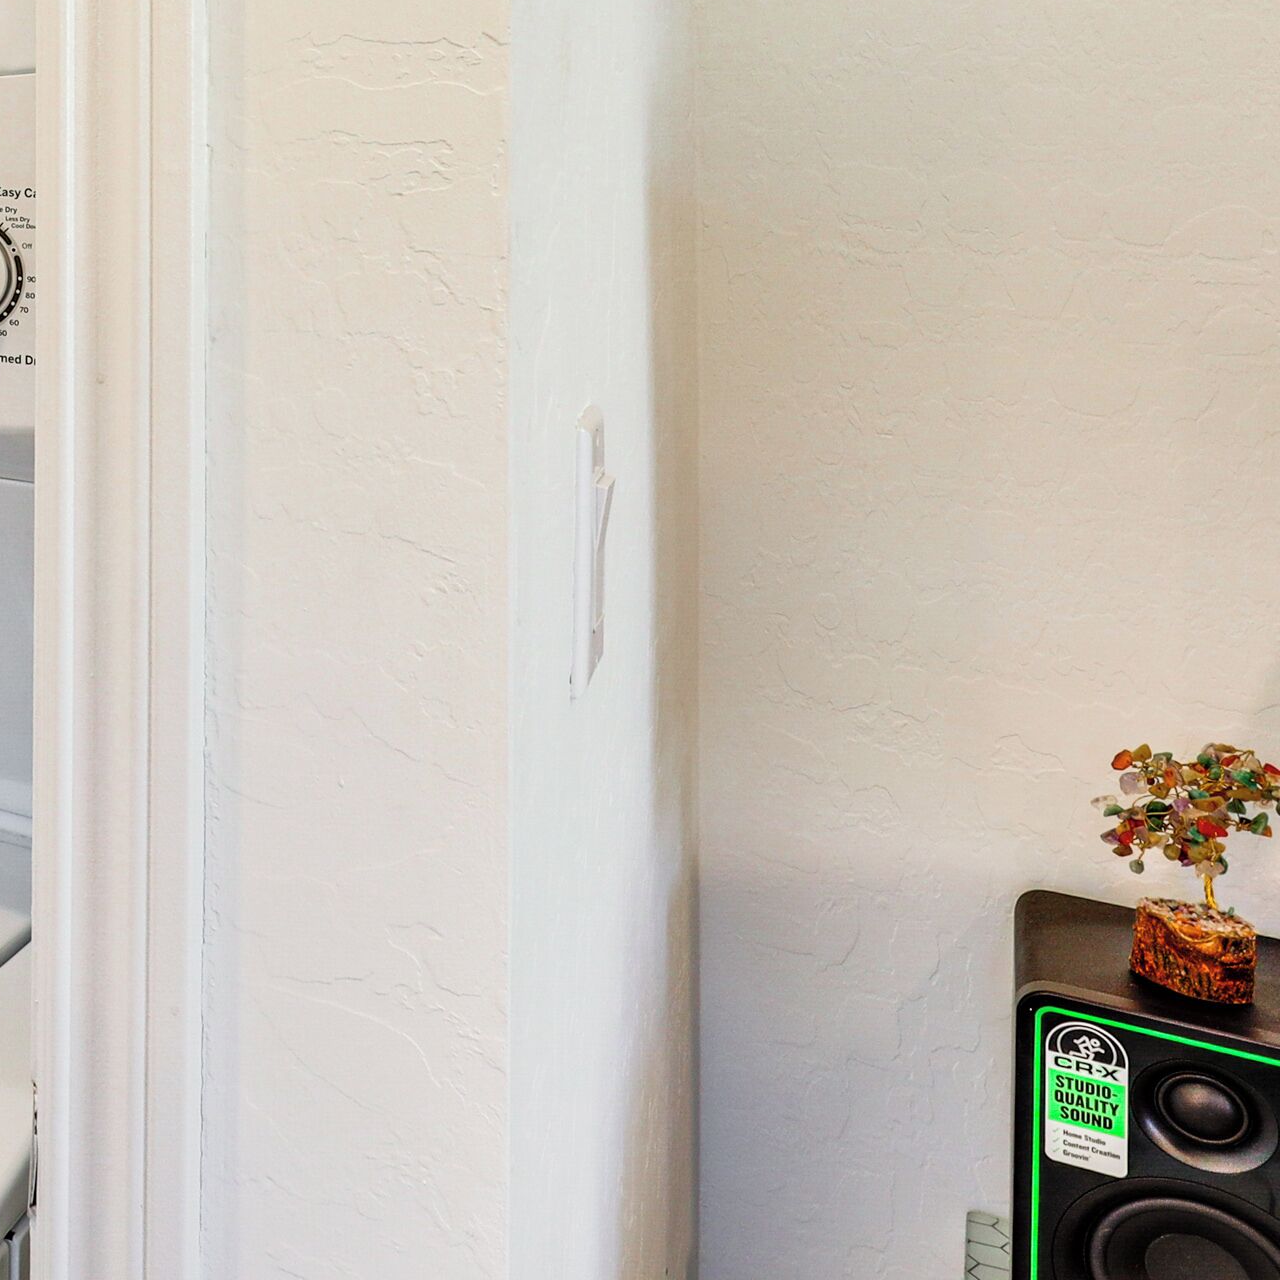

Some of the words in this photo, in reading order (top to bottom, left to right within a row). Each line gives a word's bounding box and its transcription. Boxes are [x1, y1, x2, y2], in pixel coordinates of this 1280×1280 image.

[5, 207, 18, 215] Dry
[25, 292, 36, 300] 80
[1054, 1056, 1120, 1082] CR-X
[1055, 1075, 1118, 1100] STUDIO-
[1054, 1089, 1120, 1117] QUALITY
[1060, 1106, 1113, 1130] SOUND
[1063, 1129, 1083, 1140] Home
[1084, 1134, 1106, 1146] Studio
[1063, 1139, 1090, 1152] Content
[1091, 1146, 1121, 1160] Creation
